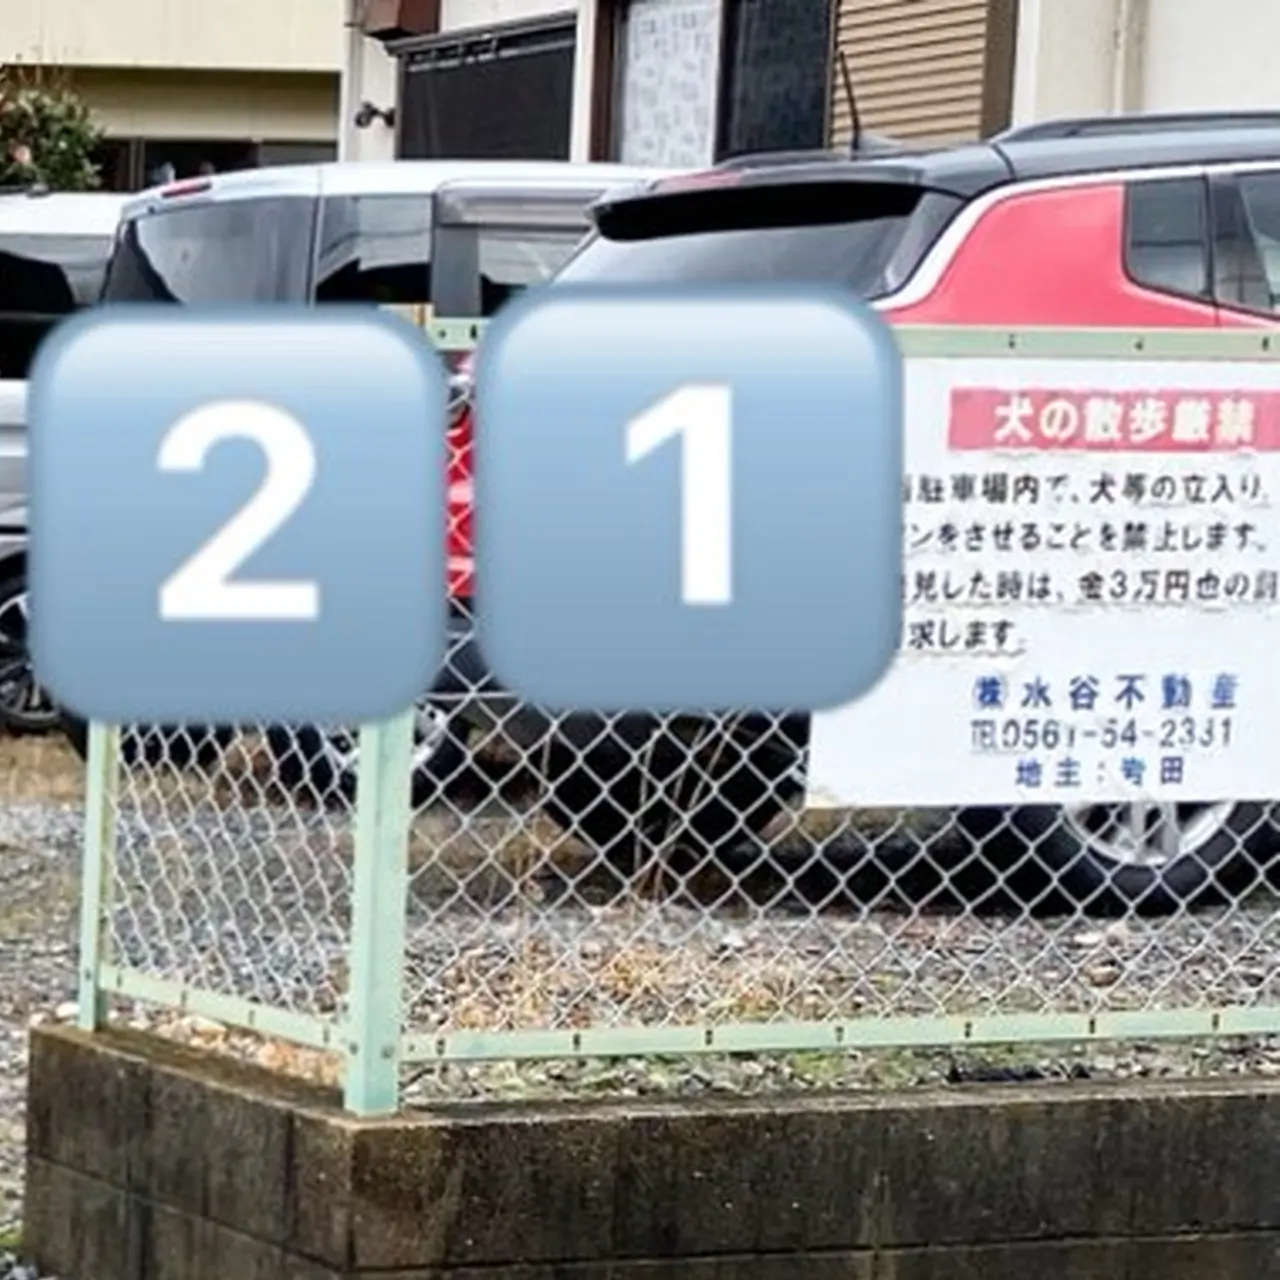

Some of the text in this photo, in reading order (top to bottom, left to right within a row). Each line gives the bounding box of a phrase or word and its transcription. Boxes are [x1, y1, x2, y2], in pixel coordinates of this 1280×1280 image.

[994, 396, 1256, 441] 犬の散歩厳禁
